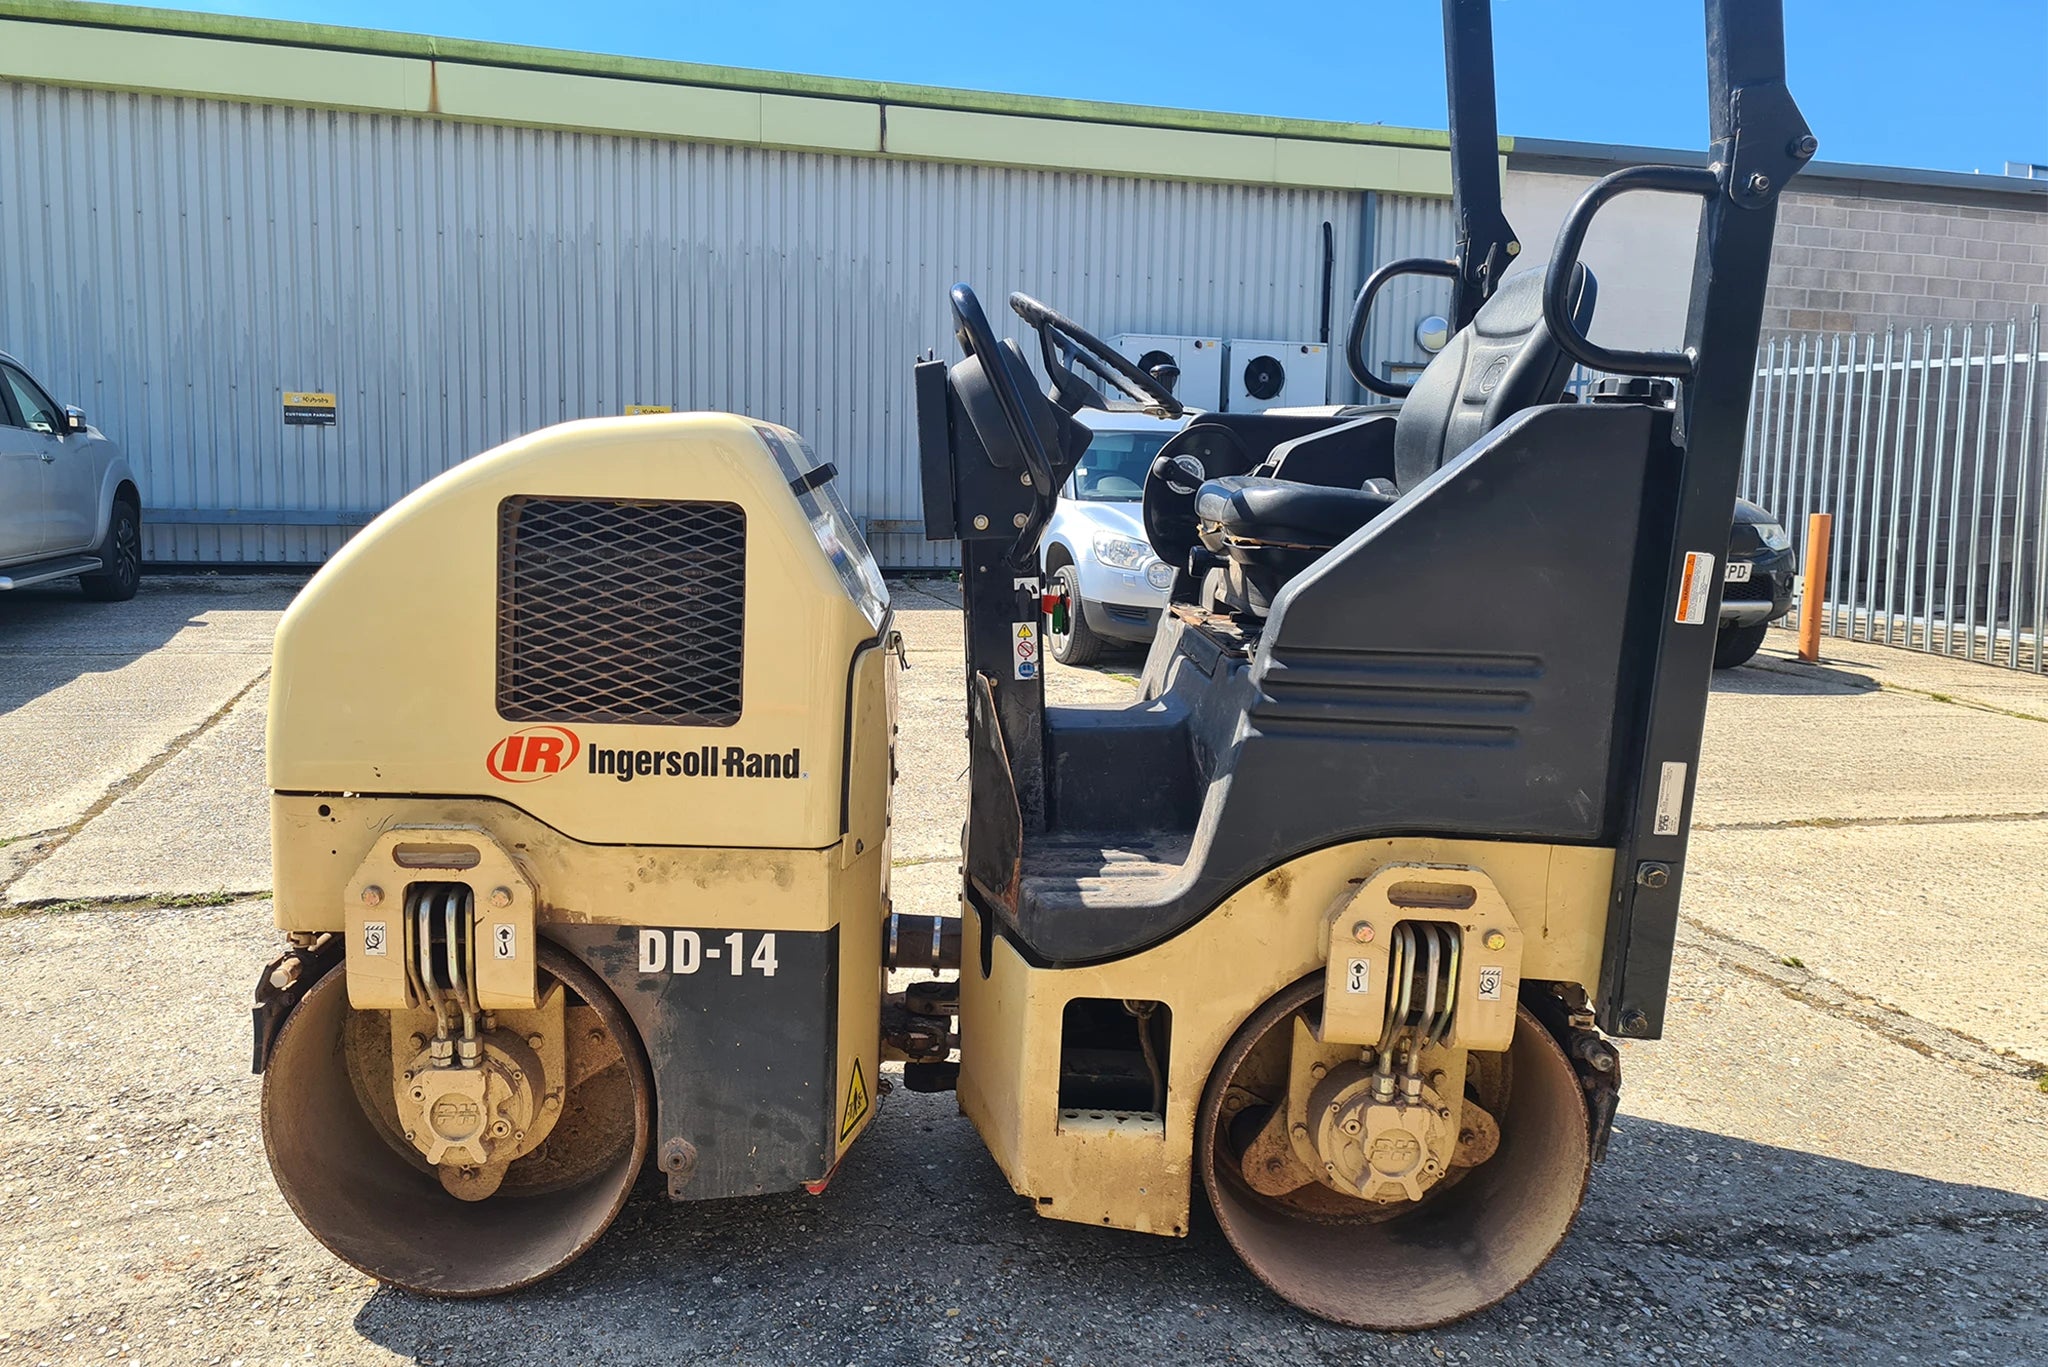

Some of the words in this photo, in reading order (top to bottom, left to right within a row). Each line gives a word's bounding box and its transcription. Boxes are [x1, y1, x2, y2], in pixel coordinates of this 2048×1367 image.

[1725, 564, 1747, 580] PD
[501, 736, 565, 774] IR
[638, 929, 779, 977] DD-14
